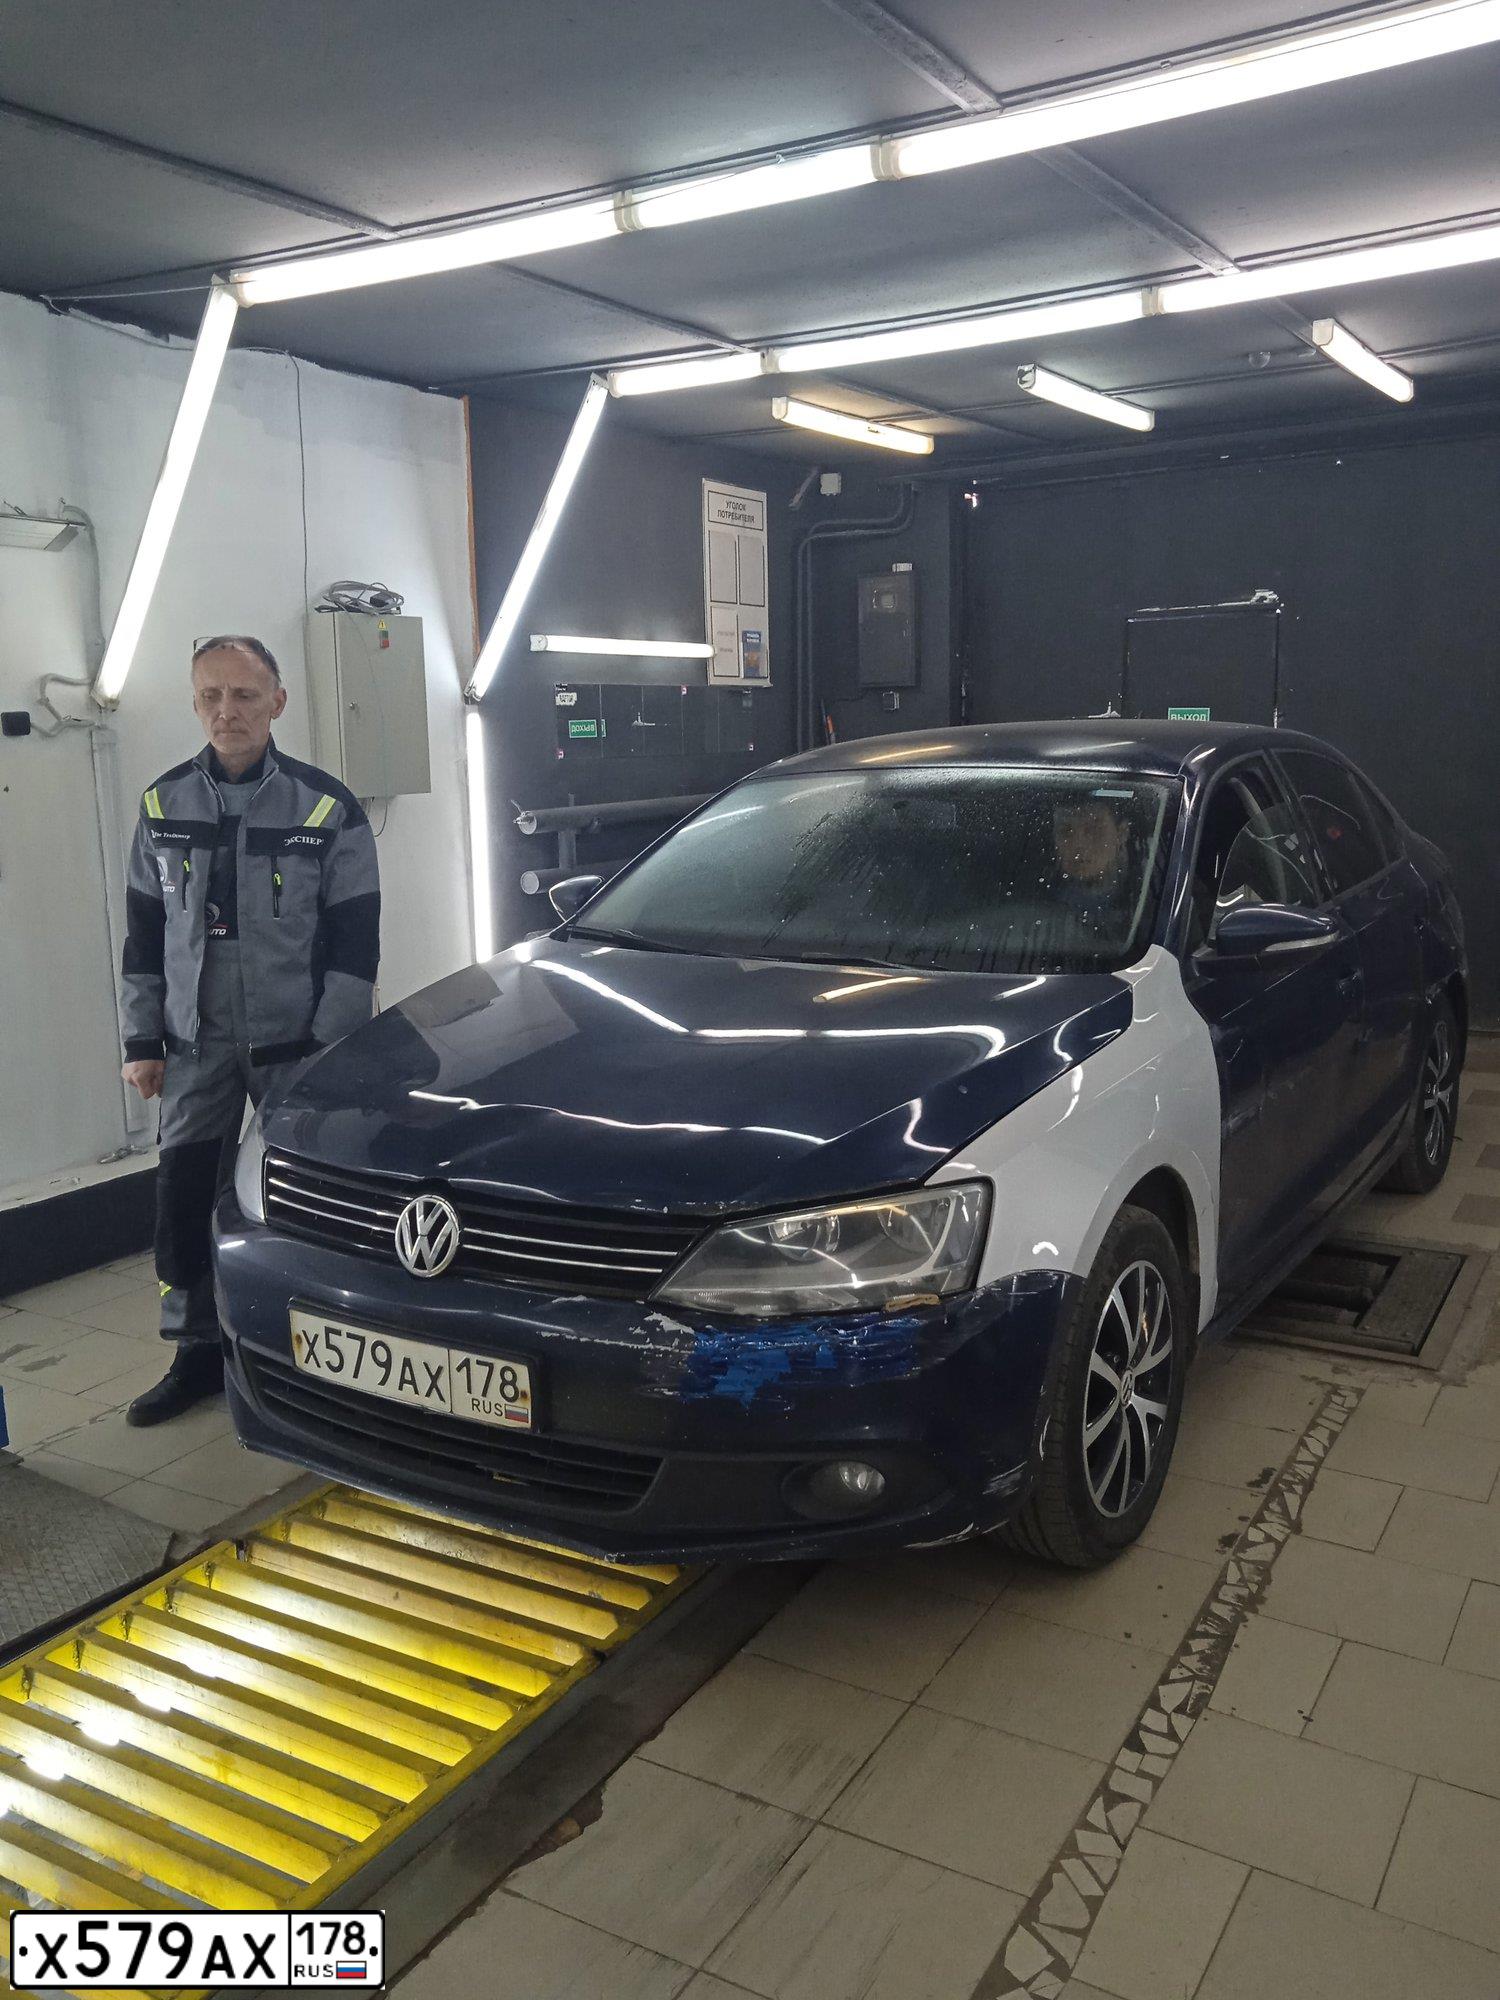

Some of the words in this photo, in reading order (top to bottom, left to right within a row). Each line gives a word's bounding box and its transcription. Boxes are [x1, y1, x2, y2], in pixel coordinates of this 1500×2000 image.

[726, 501, 746, 510] УГОЛОК
[717, 510, 754, 523] ПОТРЕБИТЕЛЯ
[455, 1357, 519, 1403] 178
[471, 1398, 503, 1417] RUS
